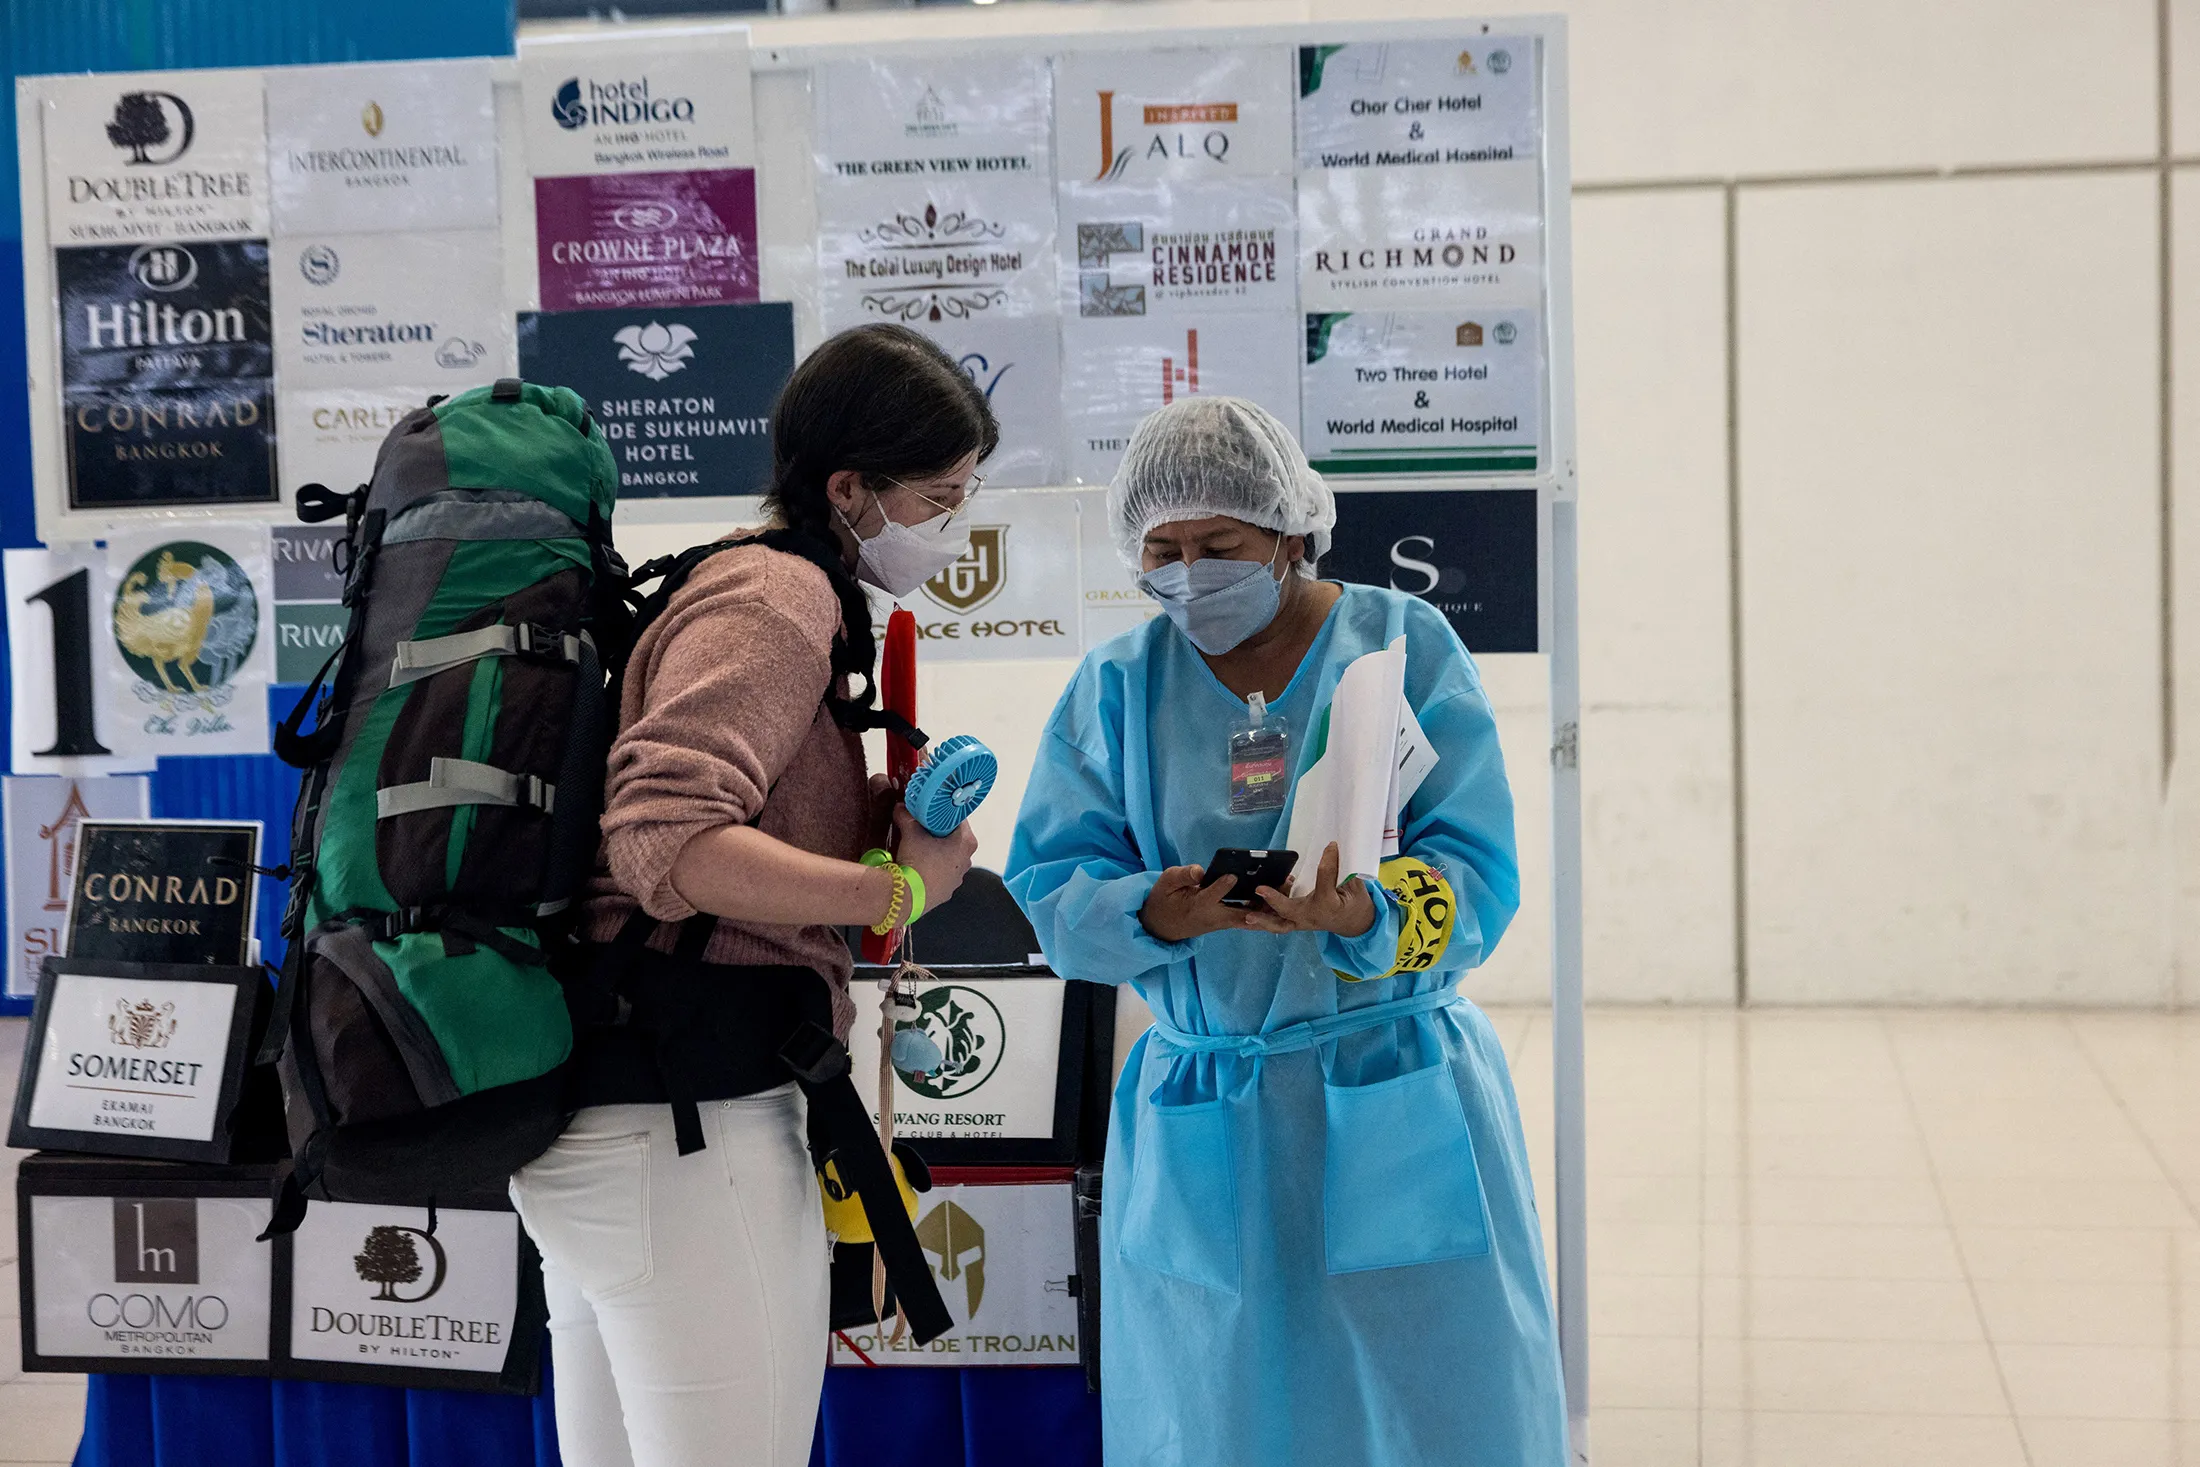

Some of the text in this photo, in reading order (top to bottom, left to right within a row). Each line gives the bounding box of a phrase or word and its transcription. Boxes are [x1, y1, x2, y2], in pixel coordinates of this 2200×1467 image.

[589, 75, 648, 101] hotel
[592, 98, 696, 125] INDIGO
[1350, 94, 1482, 115] Chor Cher Hotel
[1408, 120, 1425, 141] &
[595, 152, 644, 165] Bangkok
[698, 146, 729, 157] Road
[1322, 152, 1370, 168] World
[1376, 149, 1440, 166] Medical
[834, 156, 1031, 177] THE GREEN VIEW HOTEL
[1414, 226, 1488, 243] GRAND
[552, 235, 741, 265] CROWNE PLAZA
[1152, 242, 1275, 265] CINNAMON
[1315, 243, 1516, 274] RICHMOND
[845, 259, 866, 279] The
[903, 256, 943, 279] Luxury
[947, 255, 987, 277] Design
[990, 252, 1022, 272] Hotel
[1153, 262, 1276, 286] RESIDENCE
[1330, 274, 1501, 290] STYLISH CONVENTION HOTEL
[86, 300, 247, 348] Hilton
[302, 321, 434, 346] Sheraton
[1355, 364, 1488, 383] Two Three Hotel
[602, 397, 715, 417] SHERATON
[1414, 389, 1430, 409] &
[78, 399, 259, 432] CONRAD
[312, 406, 418, 429] CARLT
[1327, 416, 1518, 435] World Medical Hospital
[645, 417, 769, 439] SUKHUMVIT
[115, 441, 224, 461] BANGKOK
[625, 444, 695, 462] HOTEL
[1088, 439, 1122, 451] THE
[621, 470, 699, 486] BANGKOK
[279, 623, 345, 648] RIVA
[872, 620, 1065, 641] GCE HOTEL
[24, 567, 113, 757] 1
[84, 873, 239, 906] CONRAD
[109, 917, 201, 936] BANGKOK
[67, 1053, 203, 1086] SOMERSET
[102, 1100, 154, 1114] EKAMAI
[93, 1115, 156, 1131] BANGKOK
[872, 1113, 1007, 1126] SWANG RESORT
[87, 1293, 229, 1330] COMO
[104, 1331, 213, 1344] METROPOLITAN
[932, 1339, 961, 1353] DE
[966, 1335, 1075, 1353] TROJAN
[121, 1345, 196, 1355] BANGKOK
[359, 1344, 380, 1353] BY
